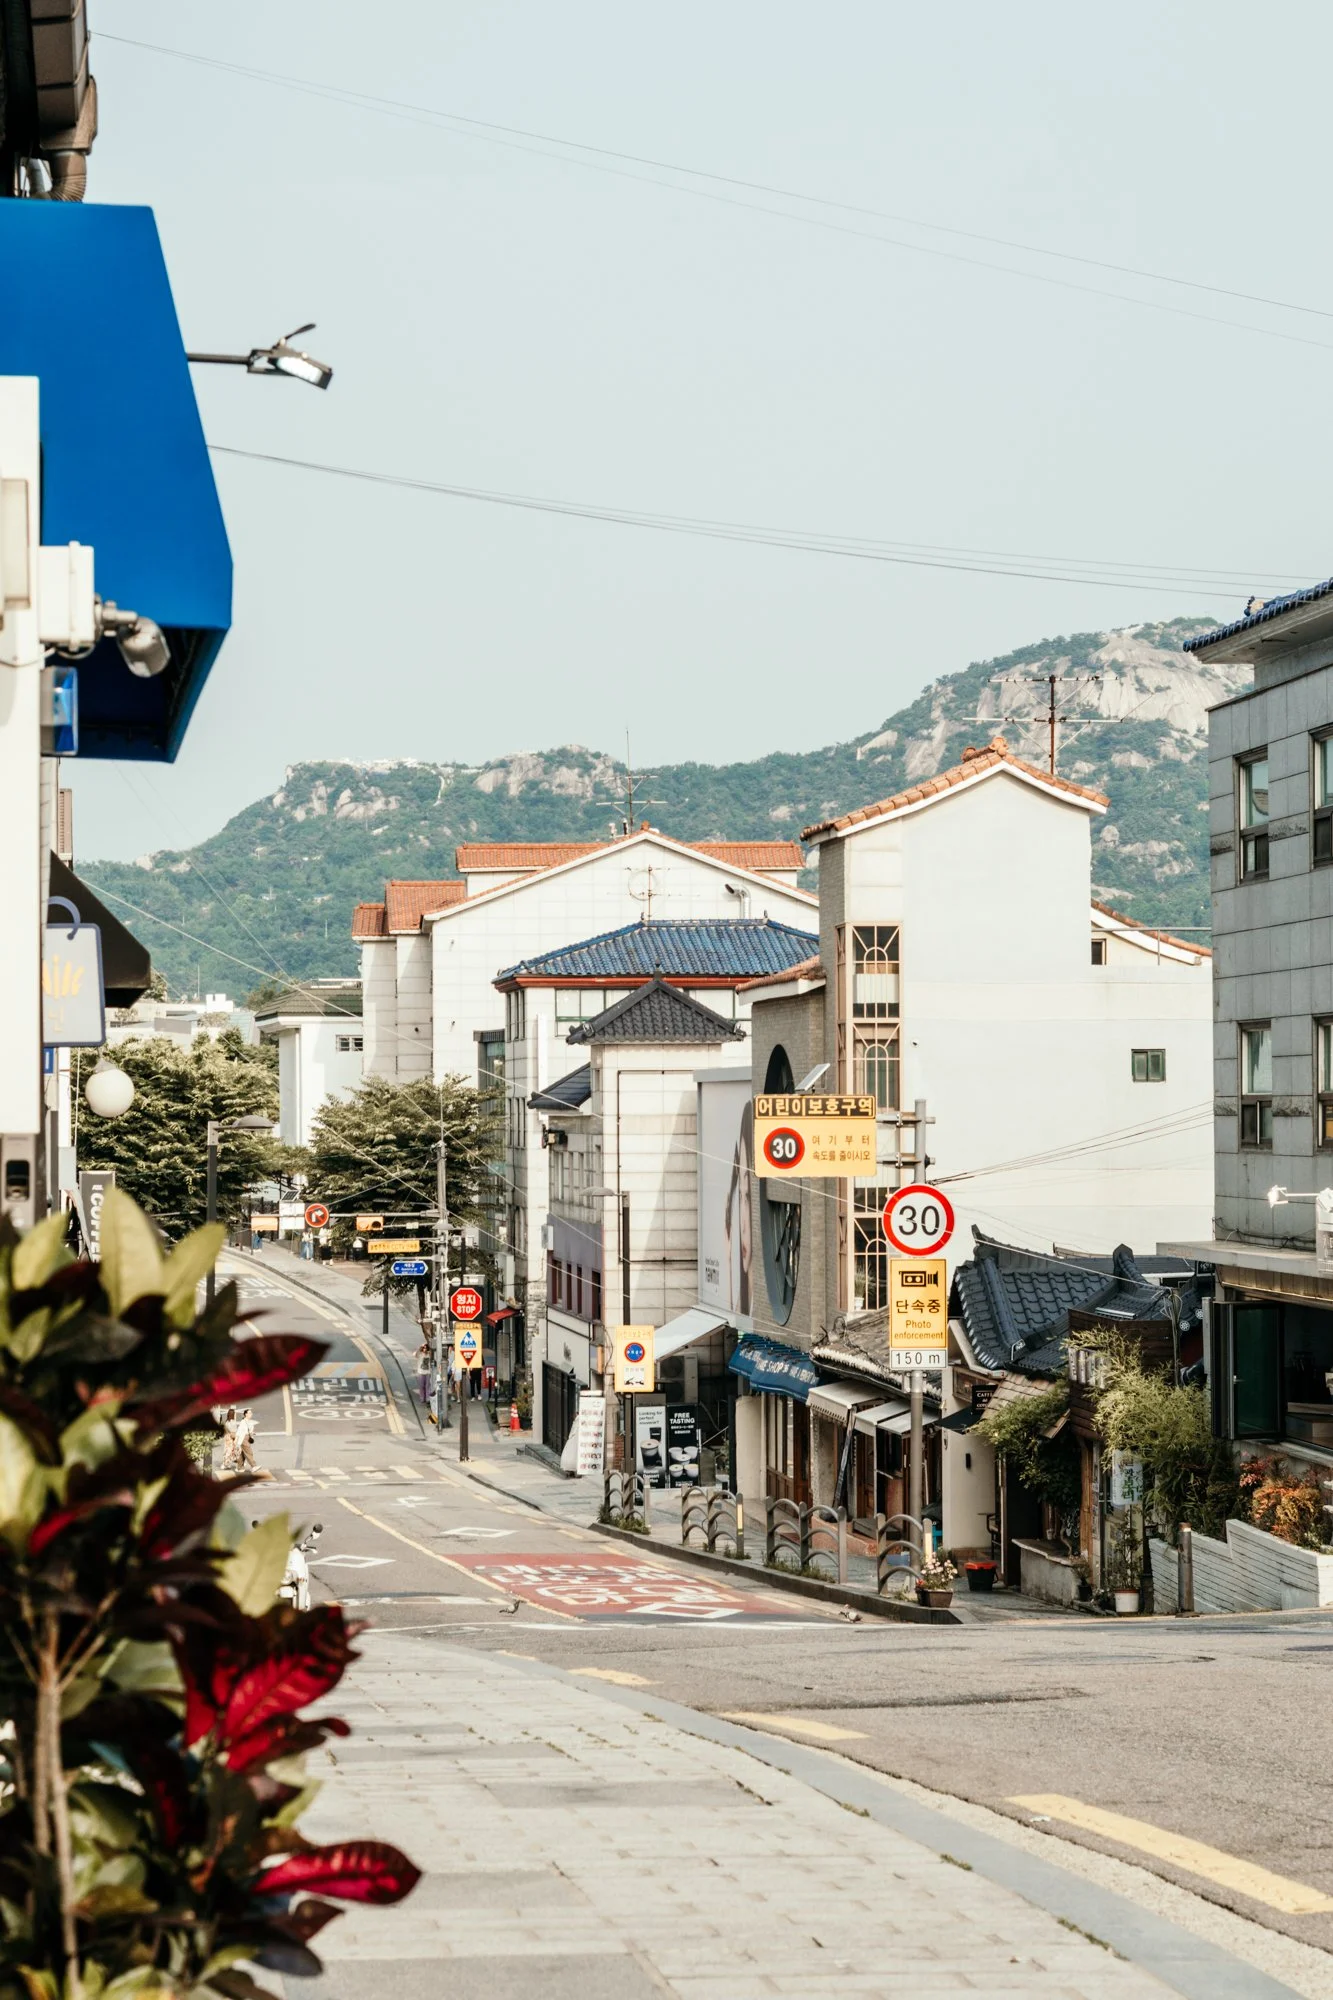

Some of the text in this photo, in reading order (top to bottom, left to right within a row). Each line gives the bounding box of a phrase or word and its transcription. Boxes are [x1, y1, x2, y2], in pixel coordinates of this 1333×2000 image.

[758, 1098, 873, 1117] 어린이보호구역
[772, 1137, 797, 1159] 30
[898, 1205, 940, 1236] 30
[457, 1294, 476, 1305] 정지
[456, 1305, 476, 1314] STOP
[895, 1299, 942, 1314] 단속중
[905, 1319, 932, 1329] Photo
[894, 1331, 944, 1340] enforcement
[895, 1352, 940, 1365] 150 m
[313, 1410, 372, 1419] 30
